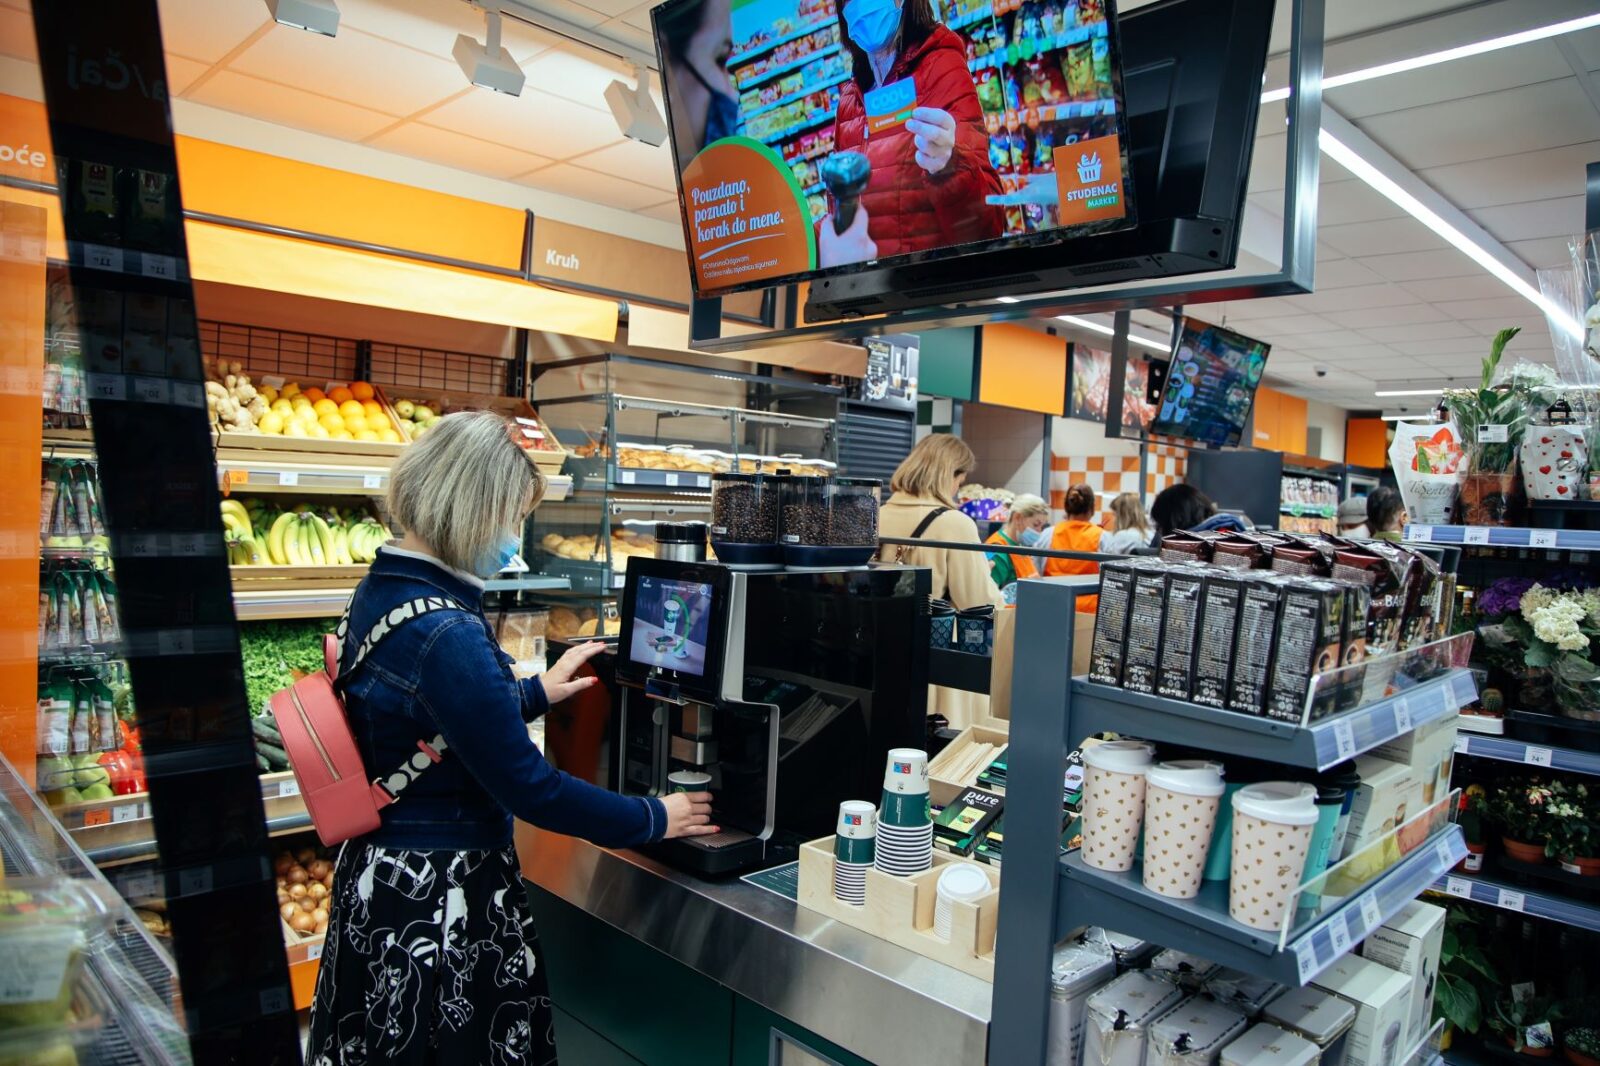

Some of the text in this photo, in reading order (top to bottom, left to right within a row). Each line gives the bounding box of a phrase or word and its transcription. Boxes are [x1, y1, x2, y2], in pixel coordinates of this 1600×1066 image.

[692, 180, 750, 205] Pouzdano,
[1066, 183, 1118, 201] STUDENAC
[1087, 196, 1116, 208] MARKET
[695, 194, 745, 228] poznato i
[698, 211, 784, 242] korak do mene.
[546, 249, 580, 271] Kruh
[962, 791, 999, 805] pure
